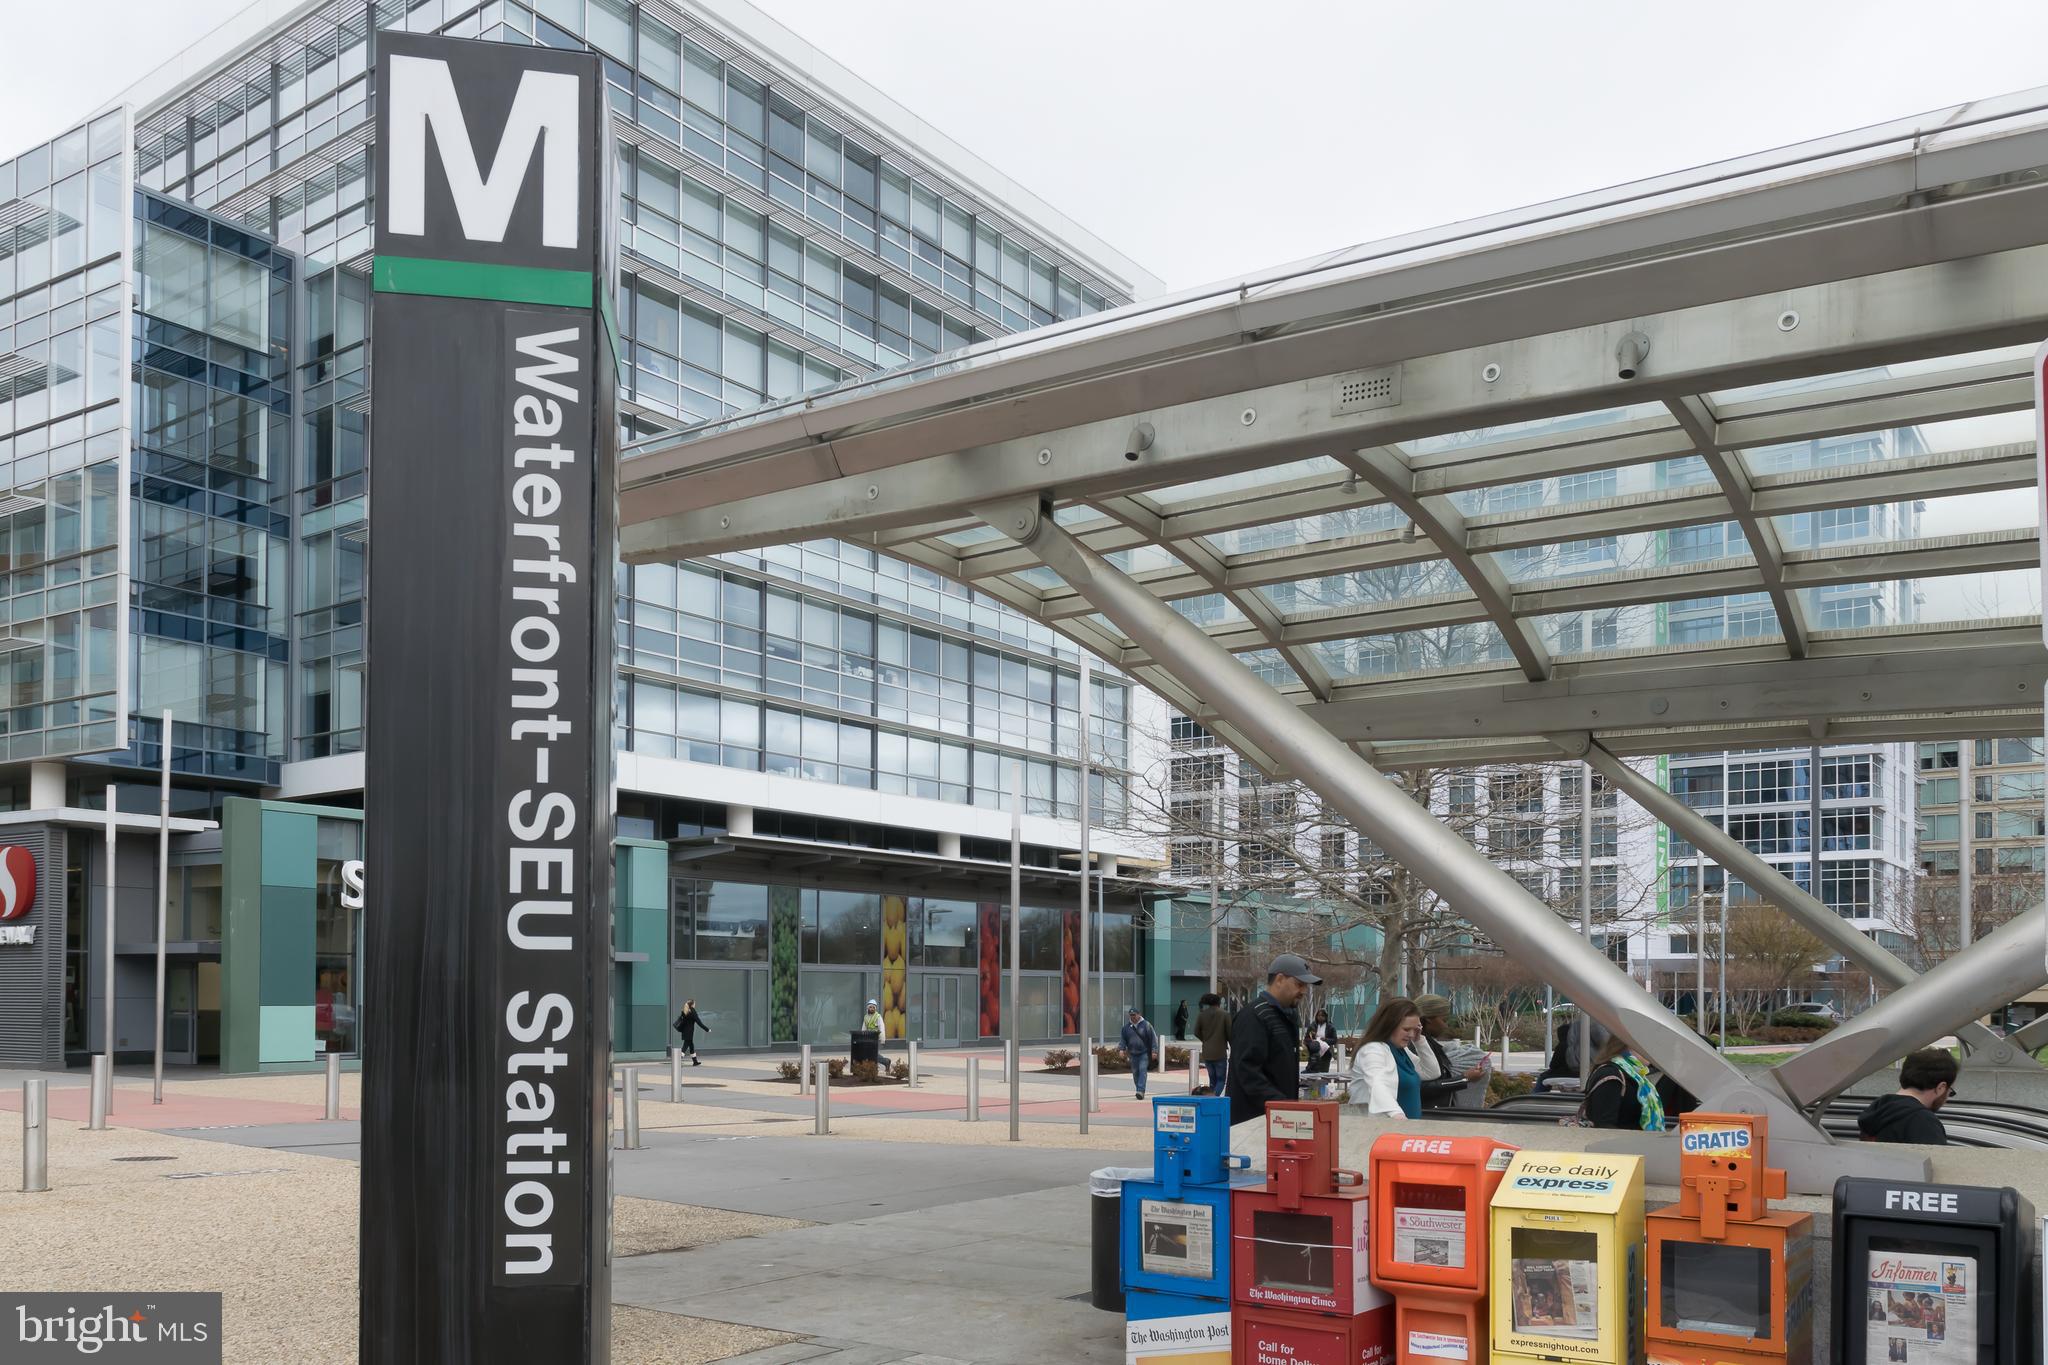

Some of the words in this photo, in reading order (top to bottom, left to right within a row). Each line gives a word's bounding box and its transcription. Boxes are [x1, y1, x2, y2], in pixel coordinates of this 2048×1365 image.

[389, 54, 579, 249] M
[507, 327, 580, 951] Waterfront-SEU
[504, 990, 574, 1275] Station
[1684, 1129, 1749, 1151] GRATIS
[1401, 1139, 1453, 1154] FREE
[1521, 1162, 1561, 1174] free
[1568, 1166, 1619, 1180] daily
[1517, 1177, 1609, 1191] express
[1885, 1190, 1958, 1213] FREE
[1409, 1215, 1463, 1230] Southwester
[1249, 1288, 1263, 1299] The
[1264, 1290, 1311, 1305] Washington
[1311, 1295, 1337, 1308] Times
[1131, 1331, 1148, 1345] The
[1149, 1327, 1206, 1343] Washington
[1207, 1324, 1230, 1341] Post
[1258, 1340, 1278, 1353] Call
[1280, 1343, 1295, 1355] for
[1510, 1338, 1600, 1355] expressnightout.com
[1258, 1352, 1287, 1365] Home
